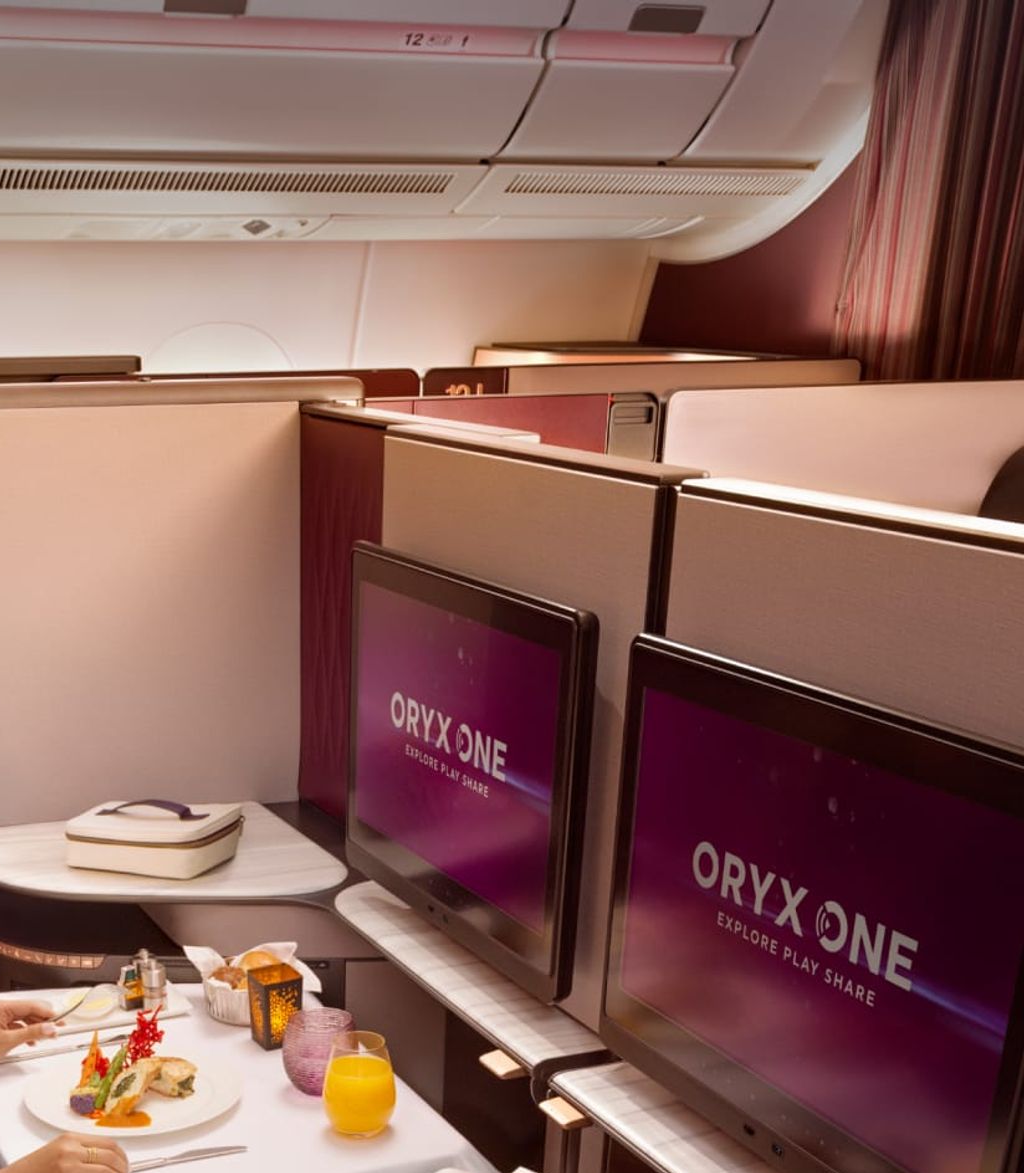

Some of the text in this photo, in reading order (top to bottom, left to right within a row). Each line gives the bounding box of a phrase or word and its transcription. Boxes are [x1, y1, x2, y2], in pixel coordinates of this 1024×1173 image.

[405, 33, 424, 46] 12
[391, 692, 507, 783] ORYX ONE
[405, 744, 489, 798] EXPLORE PLAY SHARE
[692, 841, 919, 992] ORYX ONE
[717, 911, 877, 1007] EXPLORE PLAY SHARE
